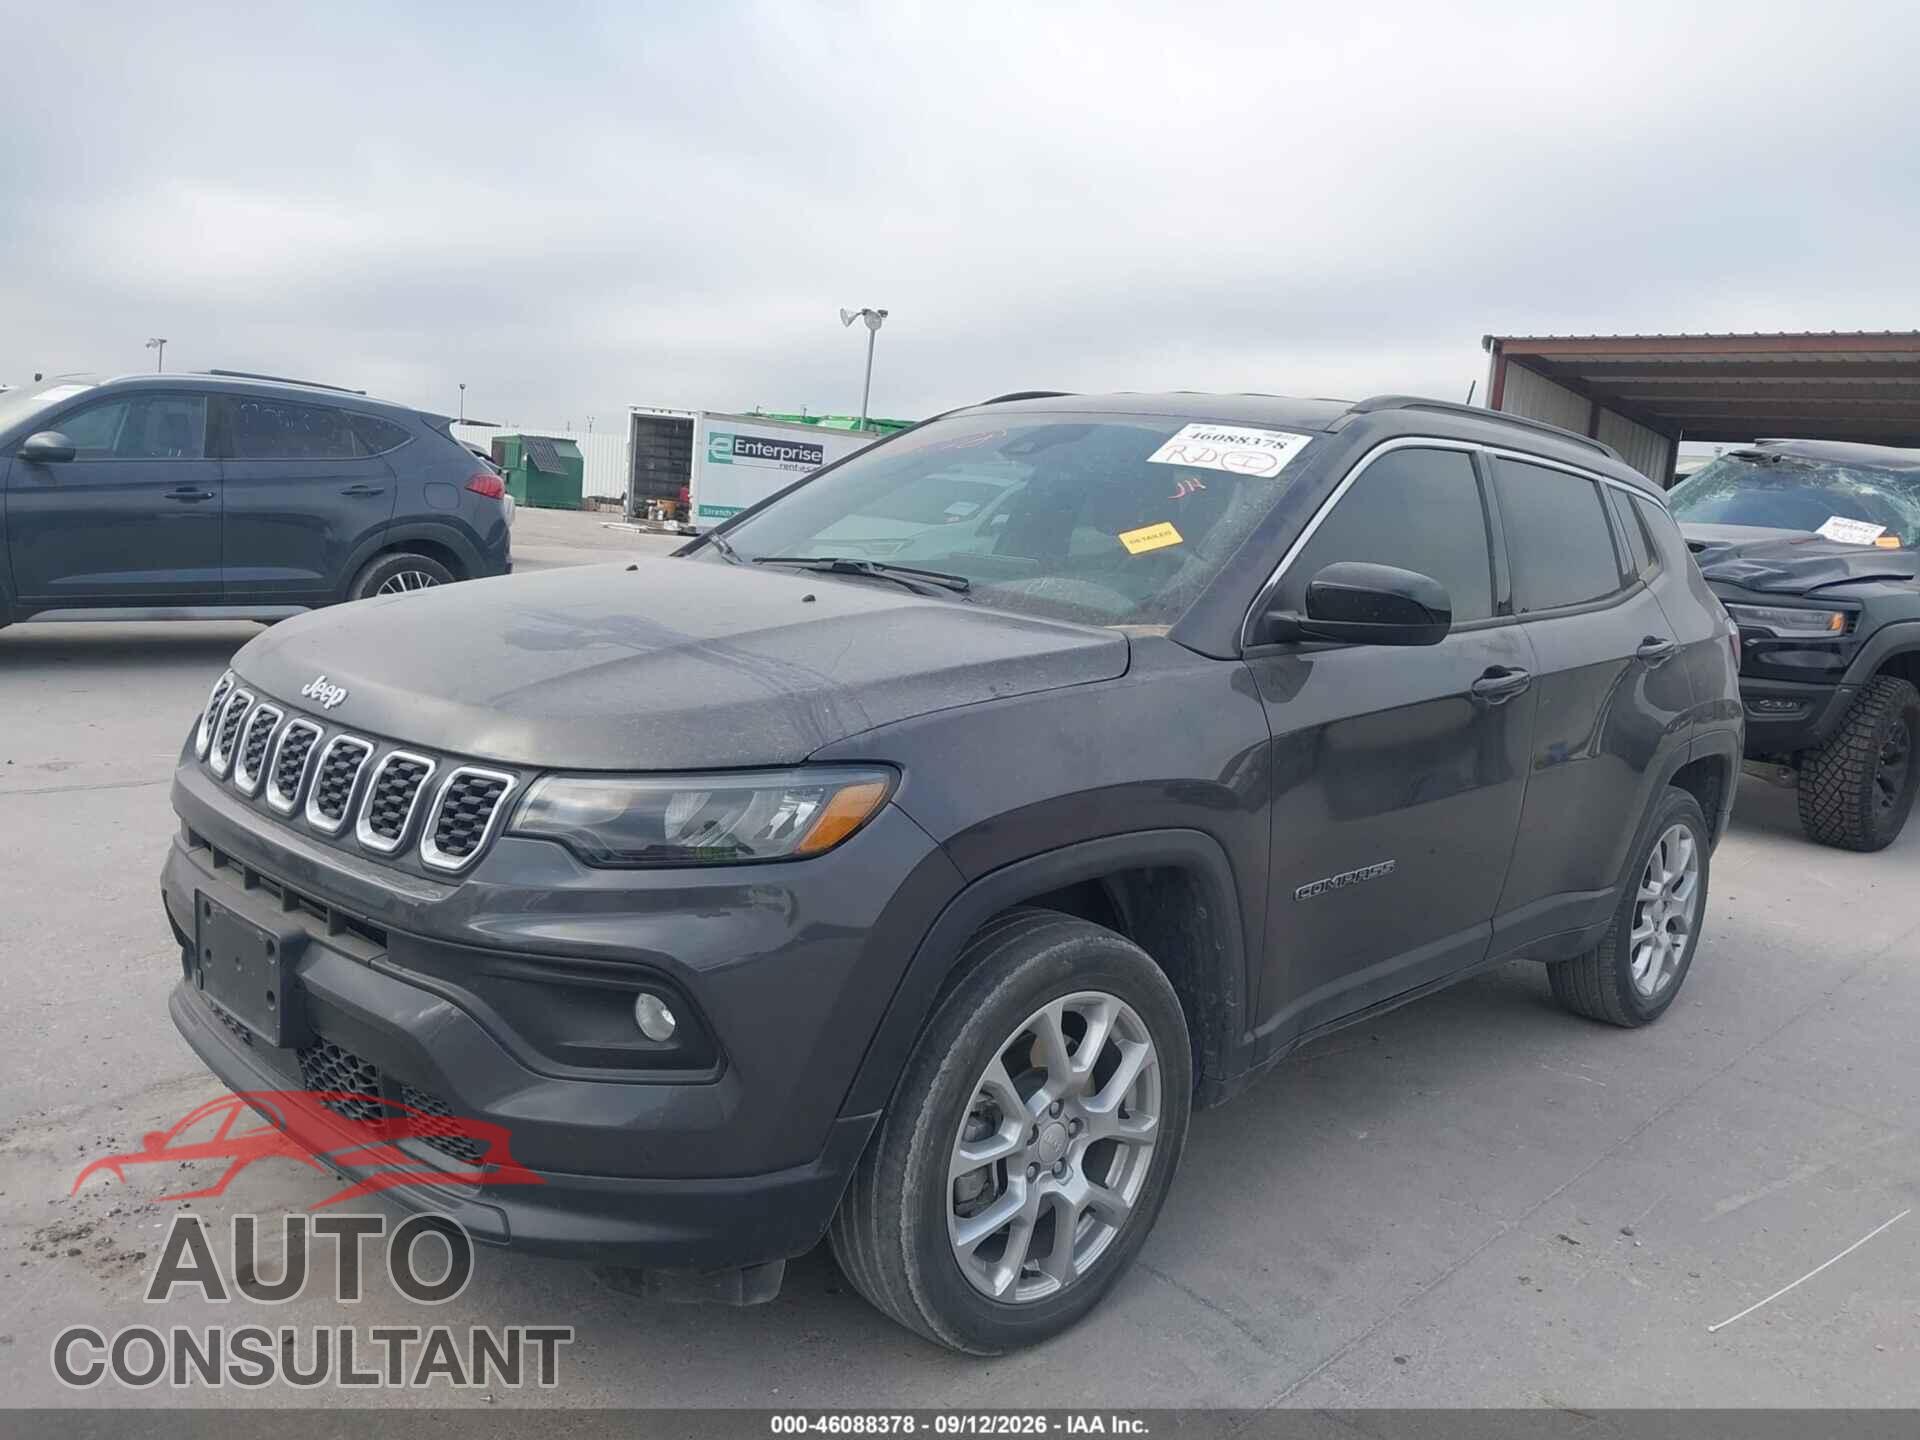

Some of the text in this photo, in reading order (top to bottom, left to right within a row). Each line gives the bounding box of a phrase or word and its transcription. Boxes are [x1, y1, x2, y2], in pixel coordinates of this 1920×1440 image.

[735, 439, 822, 462] Enterprise
[1190, 431, 1287, 450] 46088378
[779, 463, 821, 473] rent-a-c
[301, 675, 347, 709] Jeep
[1295, 859, 1396, 900] COMPASS
